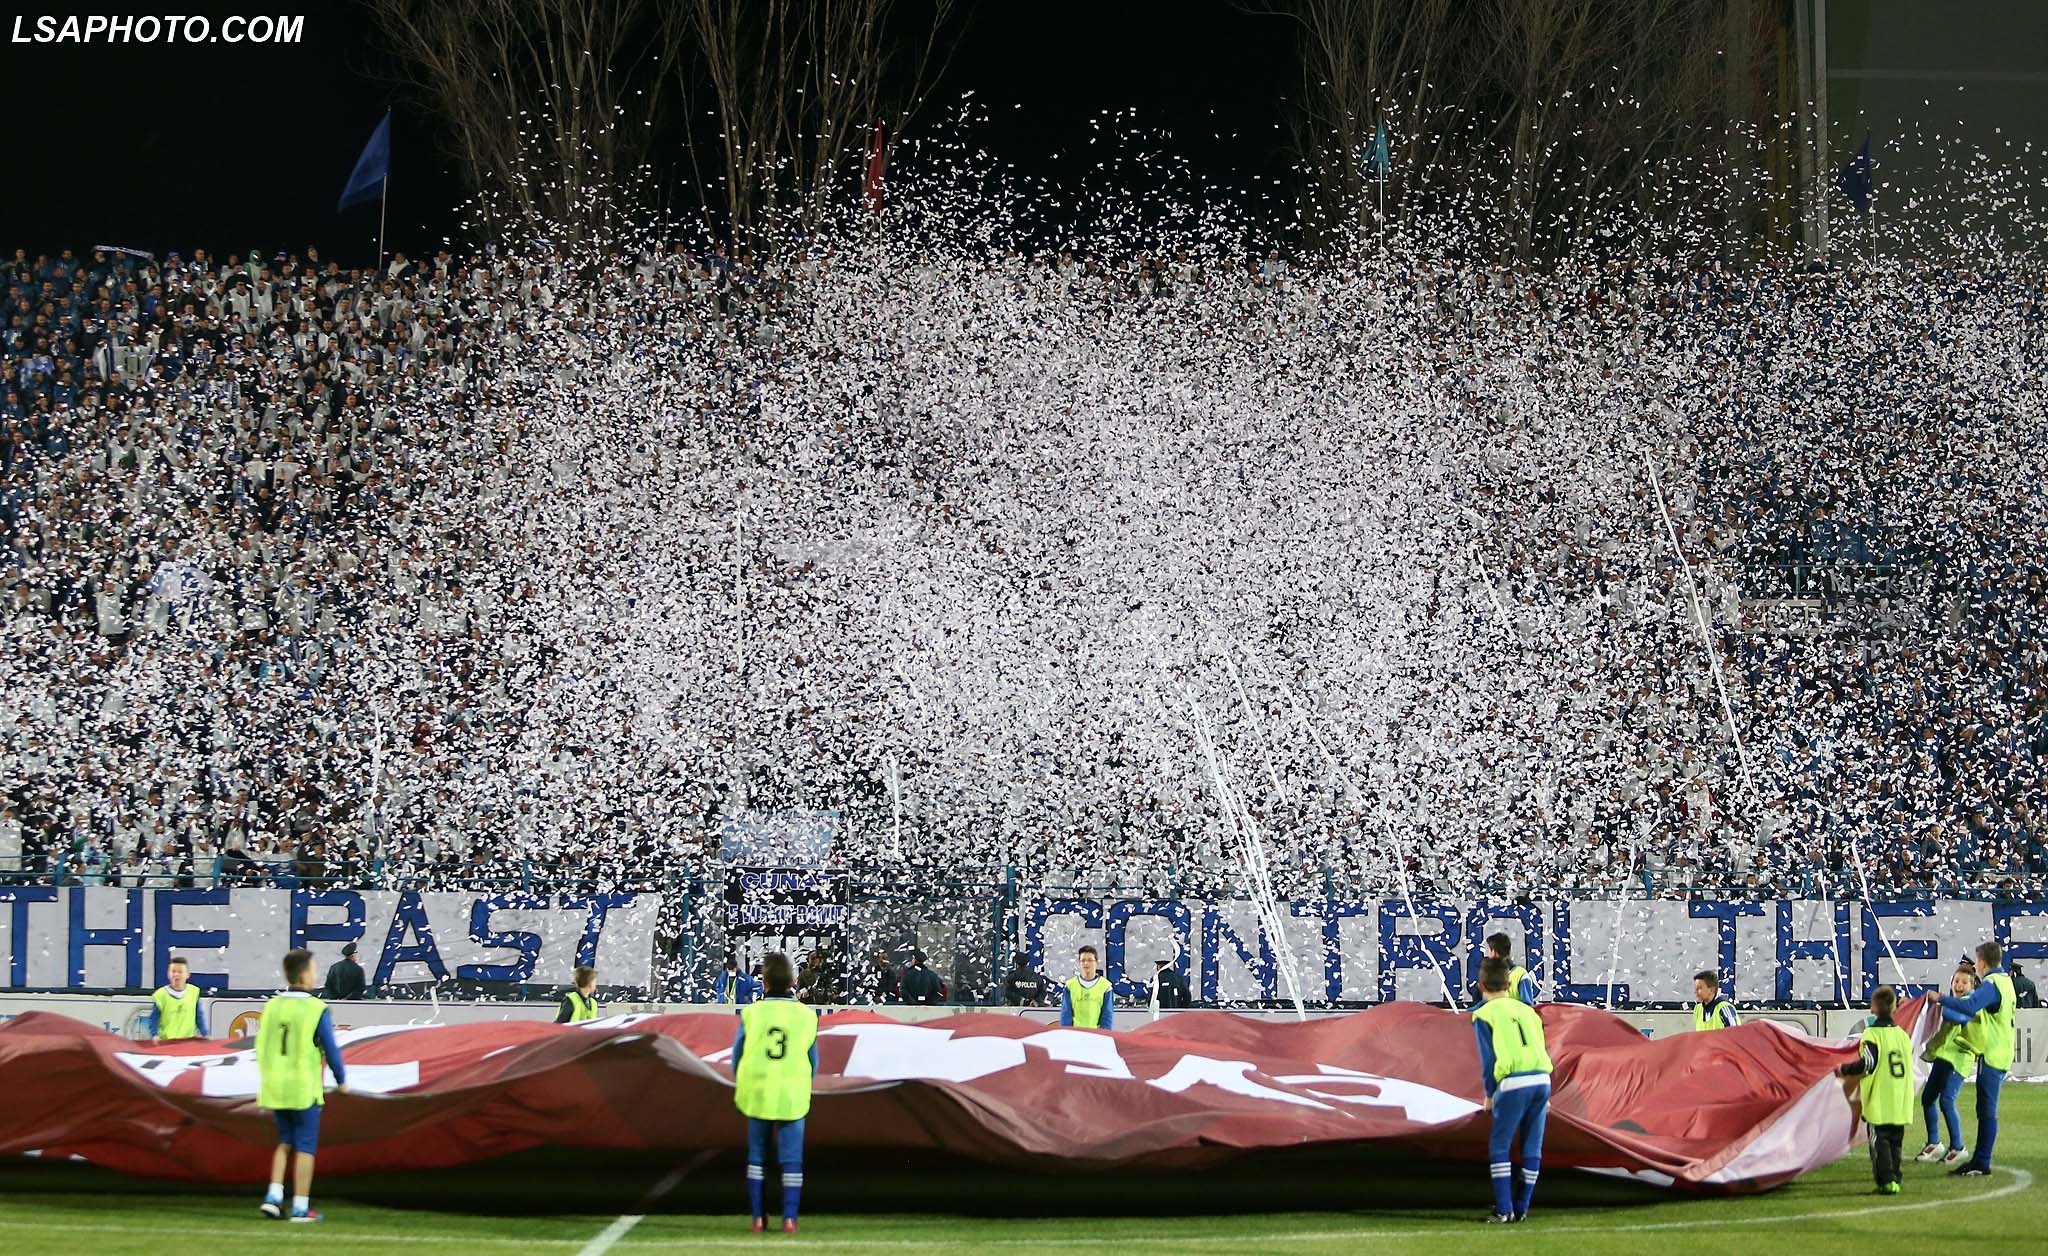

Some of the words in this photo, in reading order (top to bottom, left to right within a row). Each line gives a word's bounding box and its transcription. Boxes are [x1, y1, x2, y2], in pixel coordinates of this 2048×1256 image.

[0, 887, 230, 990] THE
[291, 889, 638, 985] PAST
[1025, 898, 1629, 1003] CONTROL
[1689, 899, 1939, 1002] THE
[766, 1026, 787, 1060] 3
[1512, 1017, 1527, 1046] 1
[1887, 1050, 1906, 1079] 6
